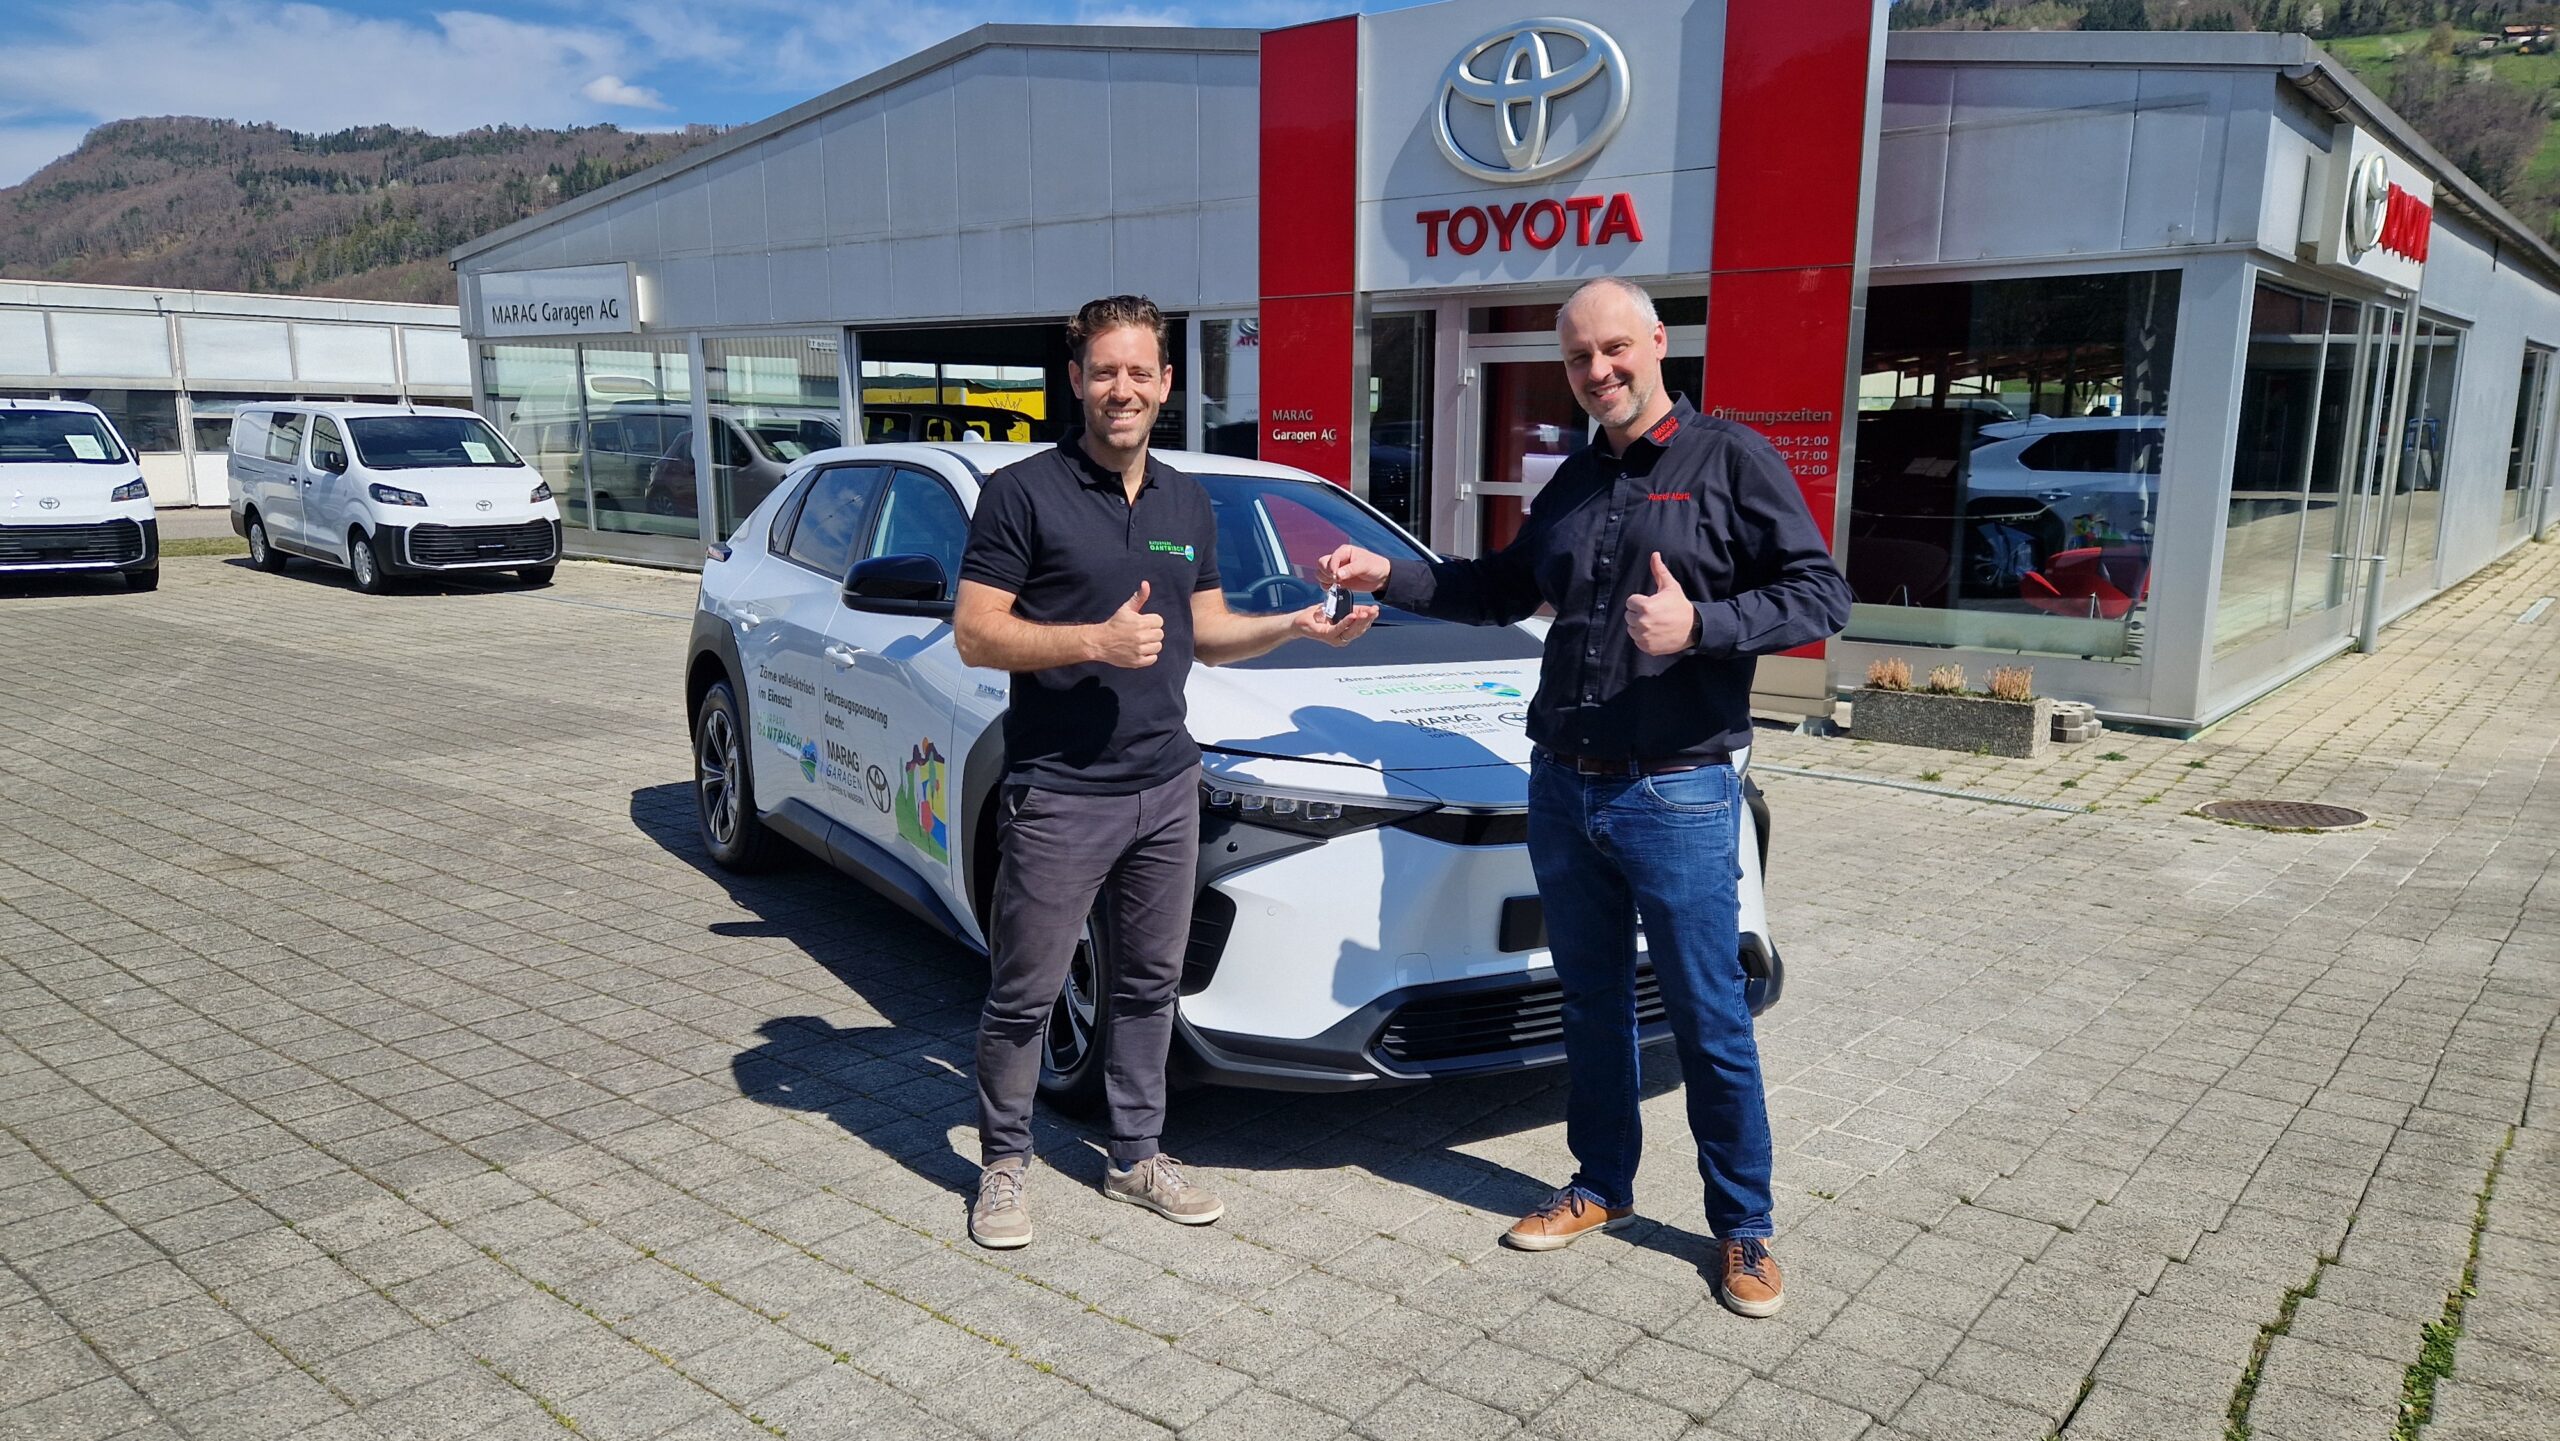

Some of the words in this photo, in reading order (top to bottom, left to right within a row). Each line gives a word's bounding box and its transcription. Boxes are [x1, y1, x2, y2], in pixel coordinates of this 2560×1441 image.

[1416, 192, 1644, 257] TOYOTA
[492, 304, 537, 324] MARAG
[542, 303, 594, 326] Garagen
[600, 299, 619, 319] AG
[1272, 409, 1313, 421] MARAG
[1711, 405, 1832, 425] Öffnungszeiten
[1272, 428, 1317, 443] Garagen
[1320, 428, 1337, 441] AG
[778, 673, 816, 697] vollelektrisch
[1358, 683, 1470, 695] GANTRISCH
[824, 687, 888, 729] Fahrzeugsponsoring
[1406, 713, 1482, 728] MARAG
[757, 721, 803, 750] GANTRISCH
[826, 739, 860, 773] MARAG
[826, 764, 863, 791] GARAGEN
